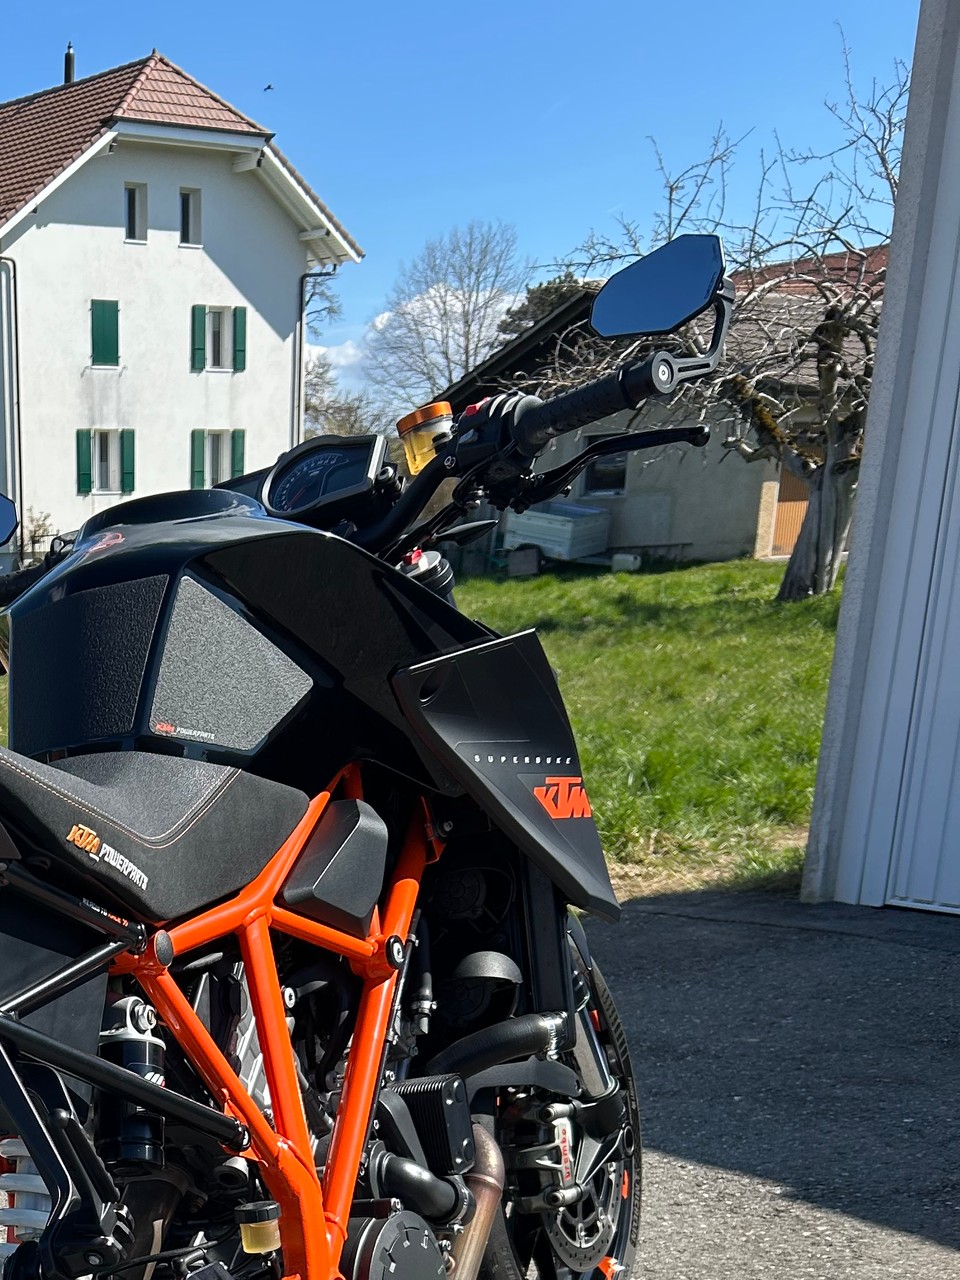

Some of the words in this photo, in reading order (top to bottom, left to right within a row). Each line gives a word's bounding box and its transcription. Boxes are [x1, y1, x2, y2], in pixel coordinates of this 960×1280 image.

[176, 727, 216, 740] POWERPARTS
[533, 776, 592, 819] KTM
[66, 823, 101, 854] KTM
[99, 843, 149, 891] POWERPARTS
[561, 1128, 572, 1181] brembo
